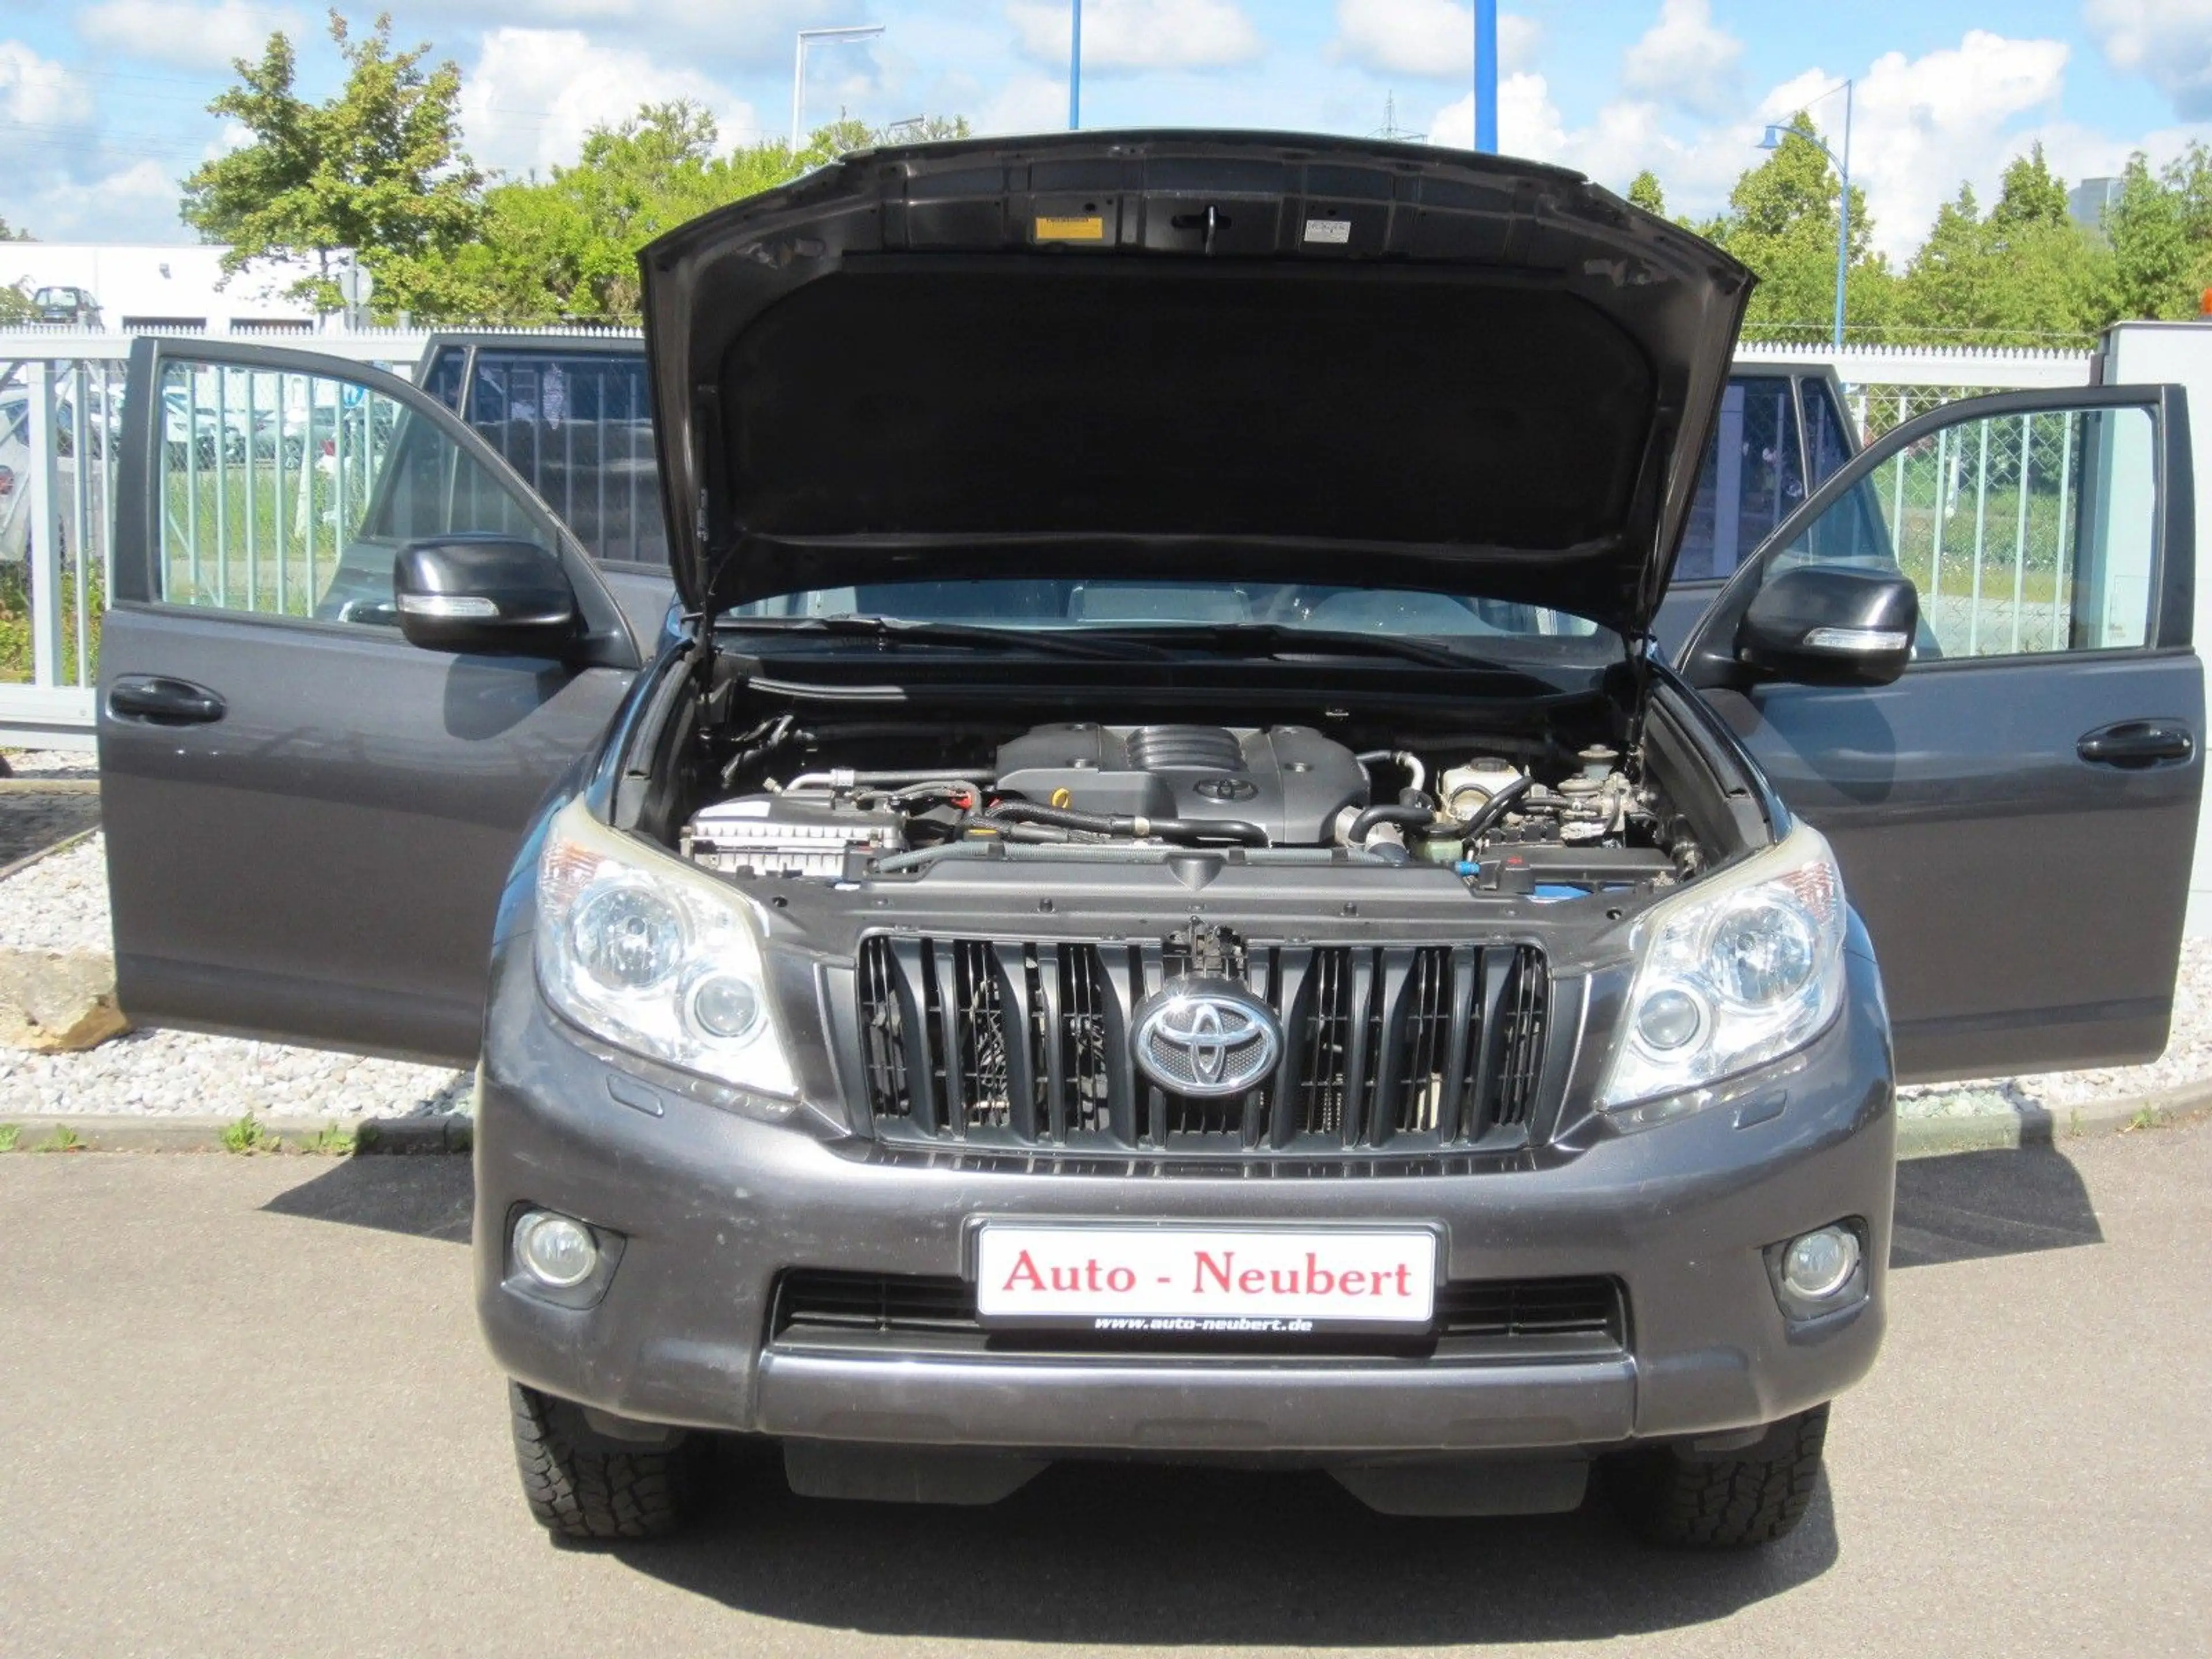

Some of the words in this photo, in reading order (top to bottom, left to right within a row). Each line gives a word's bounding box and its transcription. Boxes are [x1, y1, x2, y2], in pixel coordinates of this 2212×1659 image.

[1003, 1249, 1137, 1292] Auto
[1194, 1251, 1412, 1297] Neubert
[1094, 1317, 1313, 1331] www.auto-neubert.de
